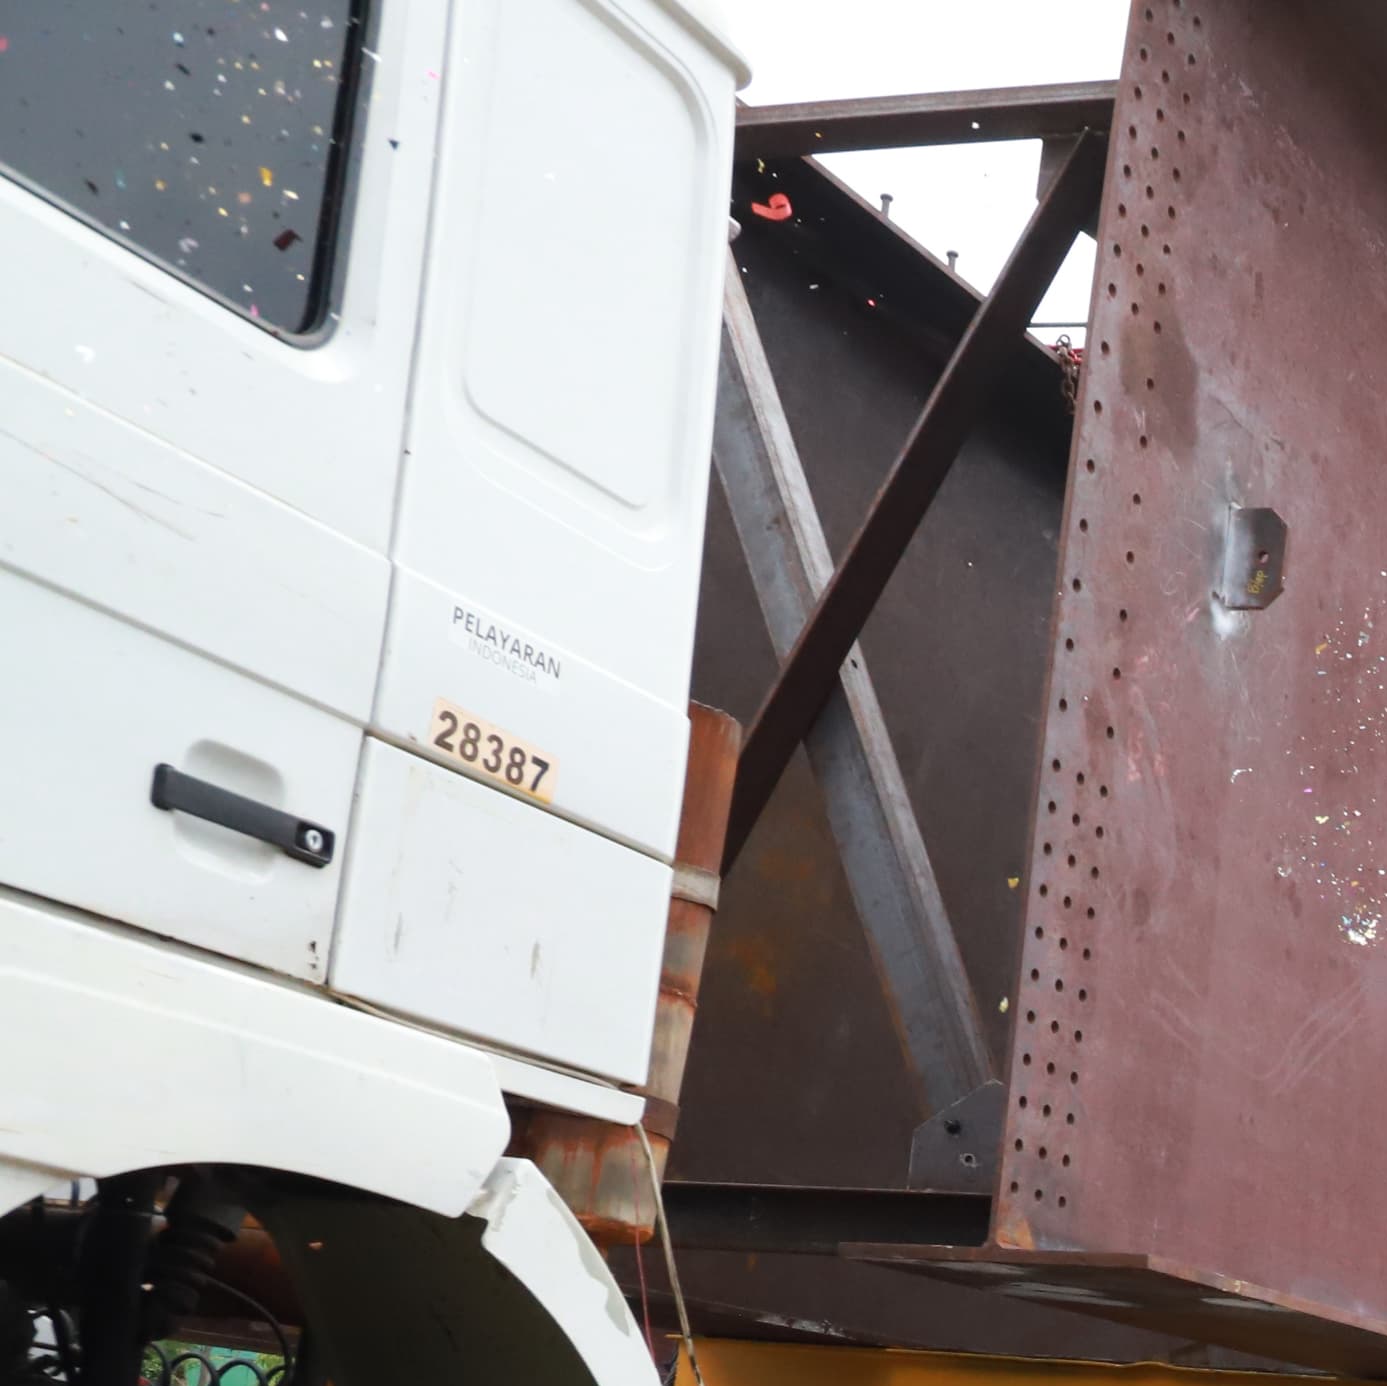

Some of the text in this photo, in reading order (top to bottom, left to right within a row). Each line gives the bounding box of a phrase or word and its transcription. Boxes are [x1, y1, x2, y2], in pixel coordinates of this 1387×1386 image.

[452, 605, 562, 679] PELAYARAN
[468, 637, 538, 685] INDONESIA
[432, 709, 551, 793] 28387
